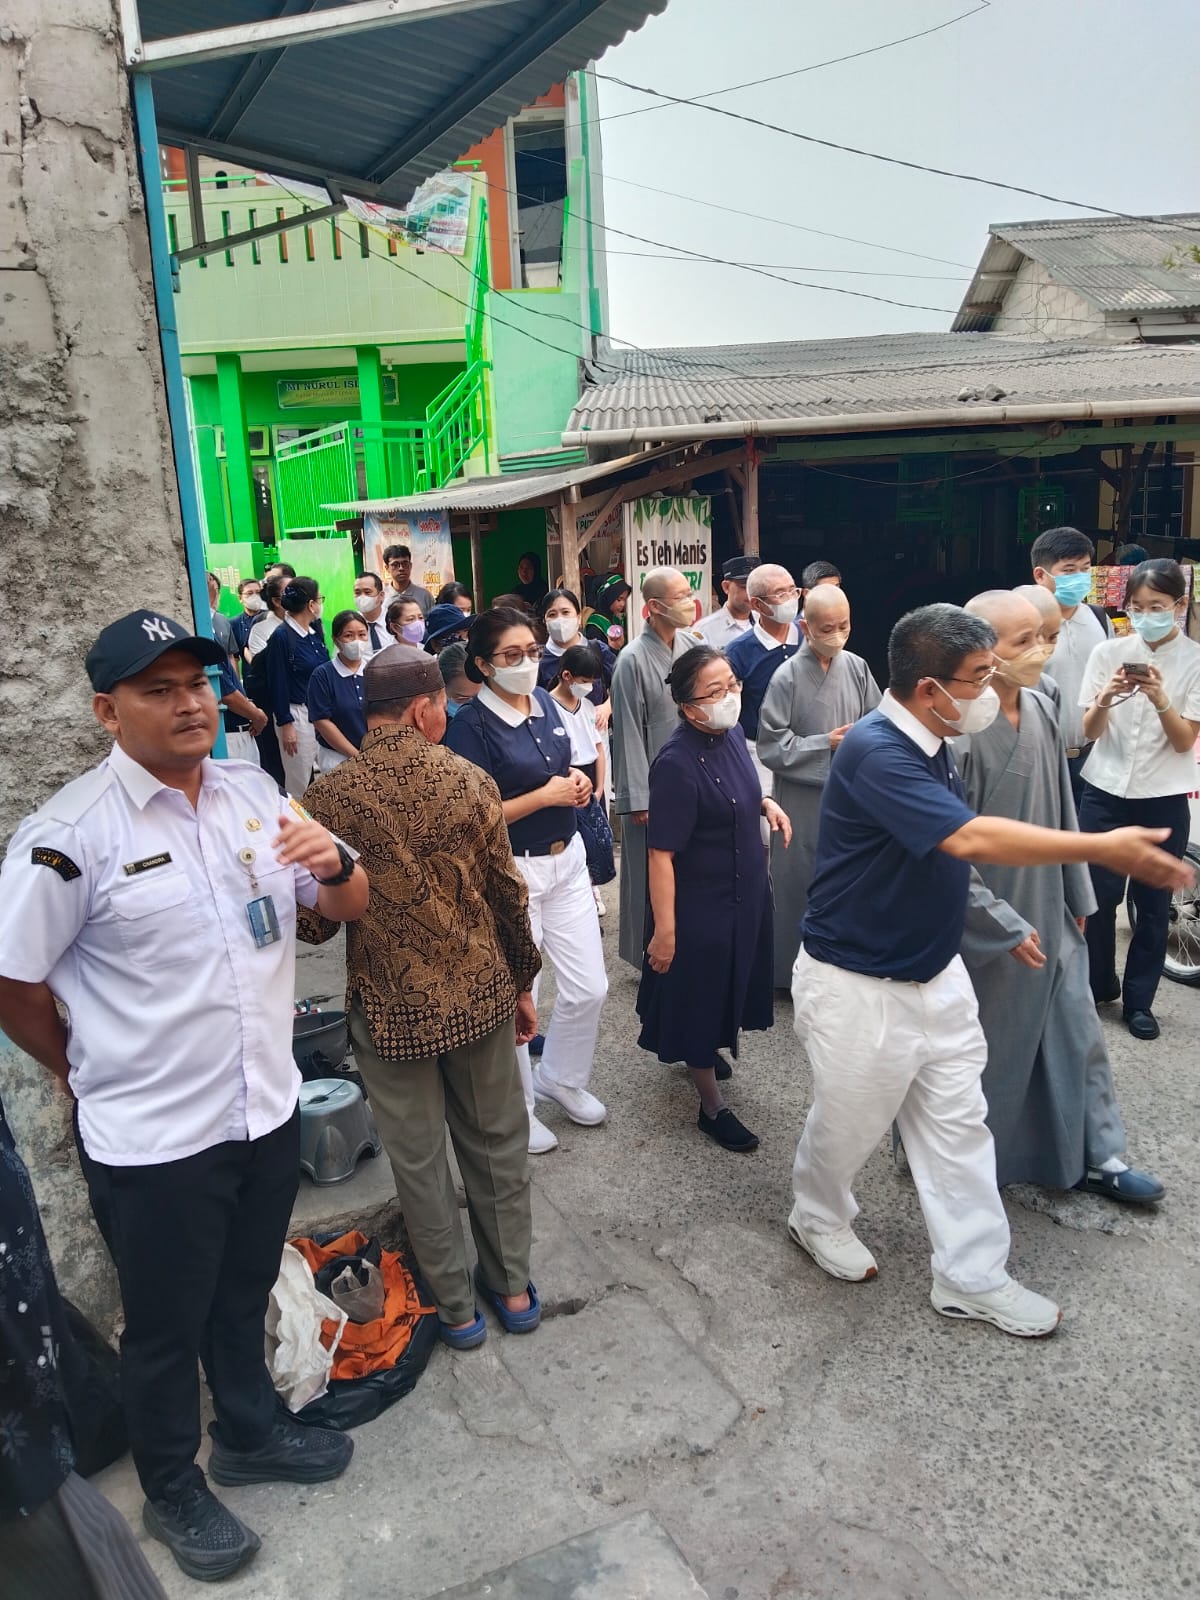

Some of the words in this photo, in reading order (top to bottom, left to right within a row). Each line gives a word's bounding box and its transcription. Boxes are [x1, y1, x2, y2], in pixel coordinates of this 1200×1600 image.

[304, 380, 339, 390] NURUL
[636, 540, 649, 566] Es
[651, 539, 672, 566] Teh
[674, 539, 707, 565] Manis
[141, 617, 176, 641] NY
